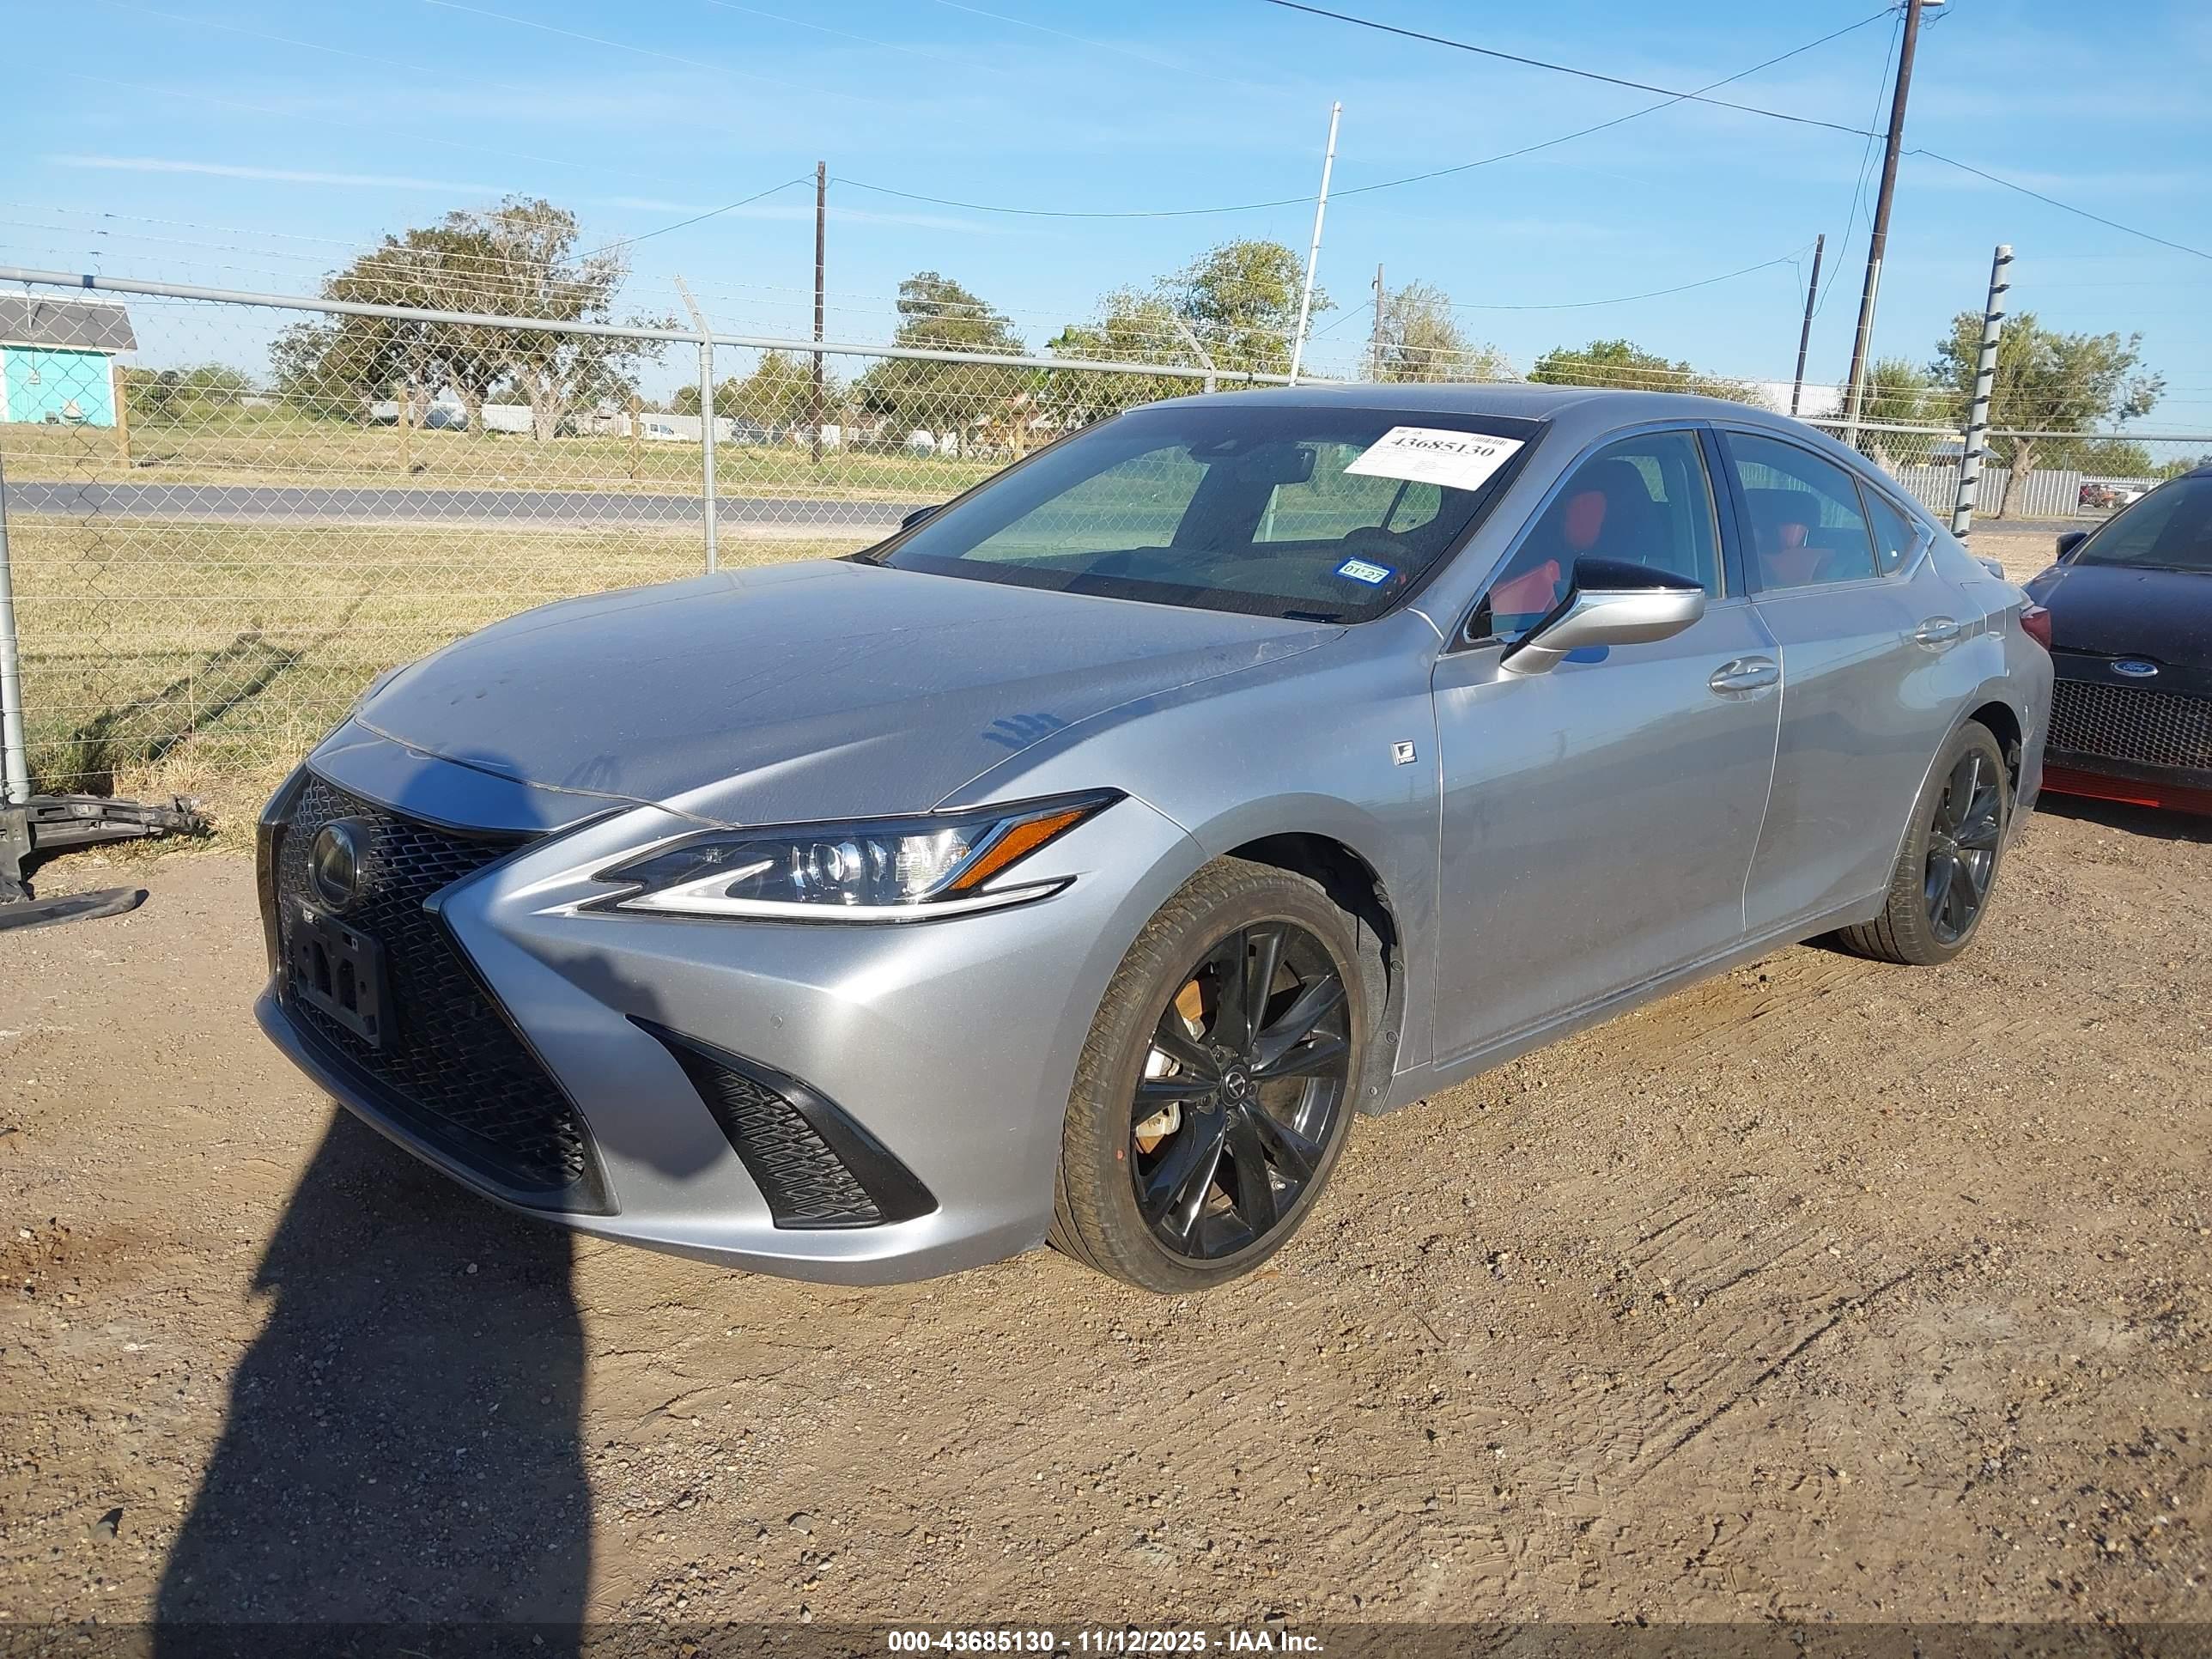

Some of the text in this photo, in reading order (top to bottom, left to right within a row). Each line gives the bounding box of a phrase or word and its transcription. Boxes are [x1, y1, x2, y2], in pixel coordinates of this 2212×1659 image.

[1391, 437, 1495, 457] 43685130
[1343, 565, 1360, 574] 01
[1364, 571, 1383, 580] 27
[2123, 663, 2148, 672] Ford
